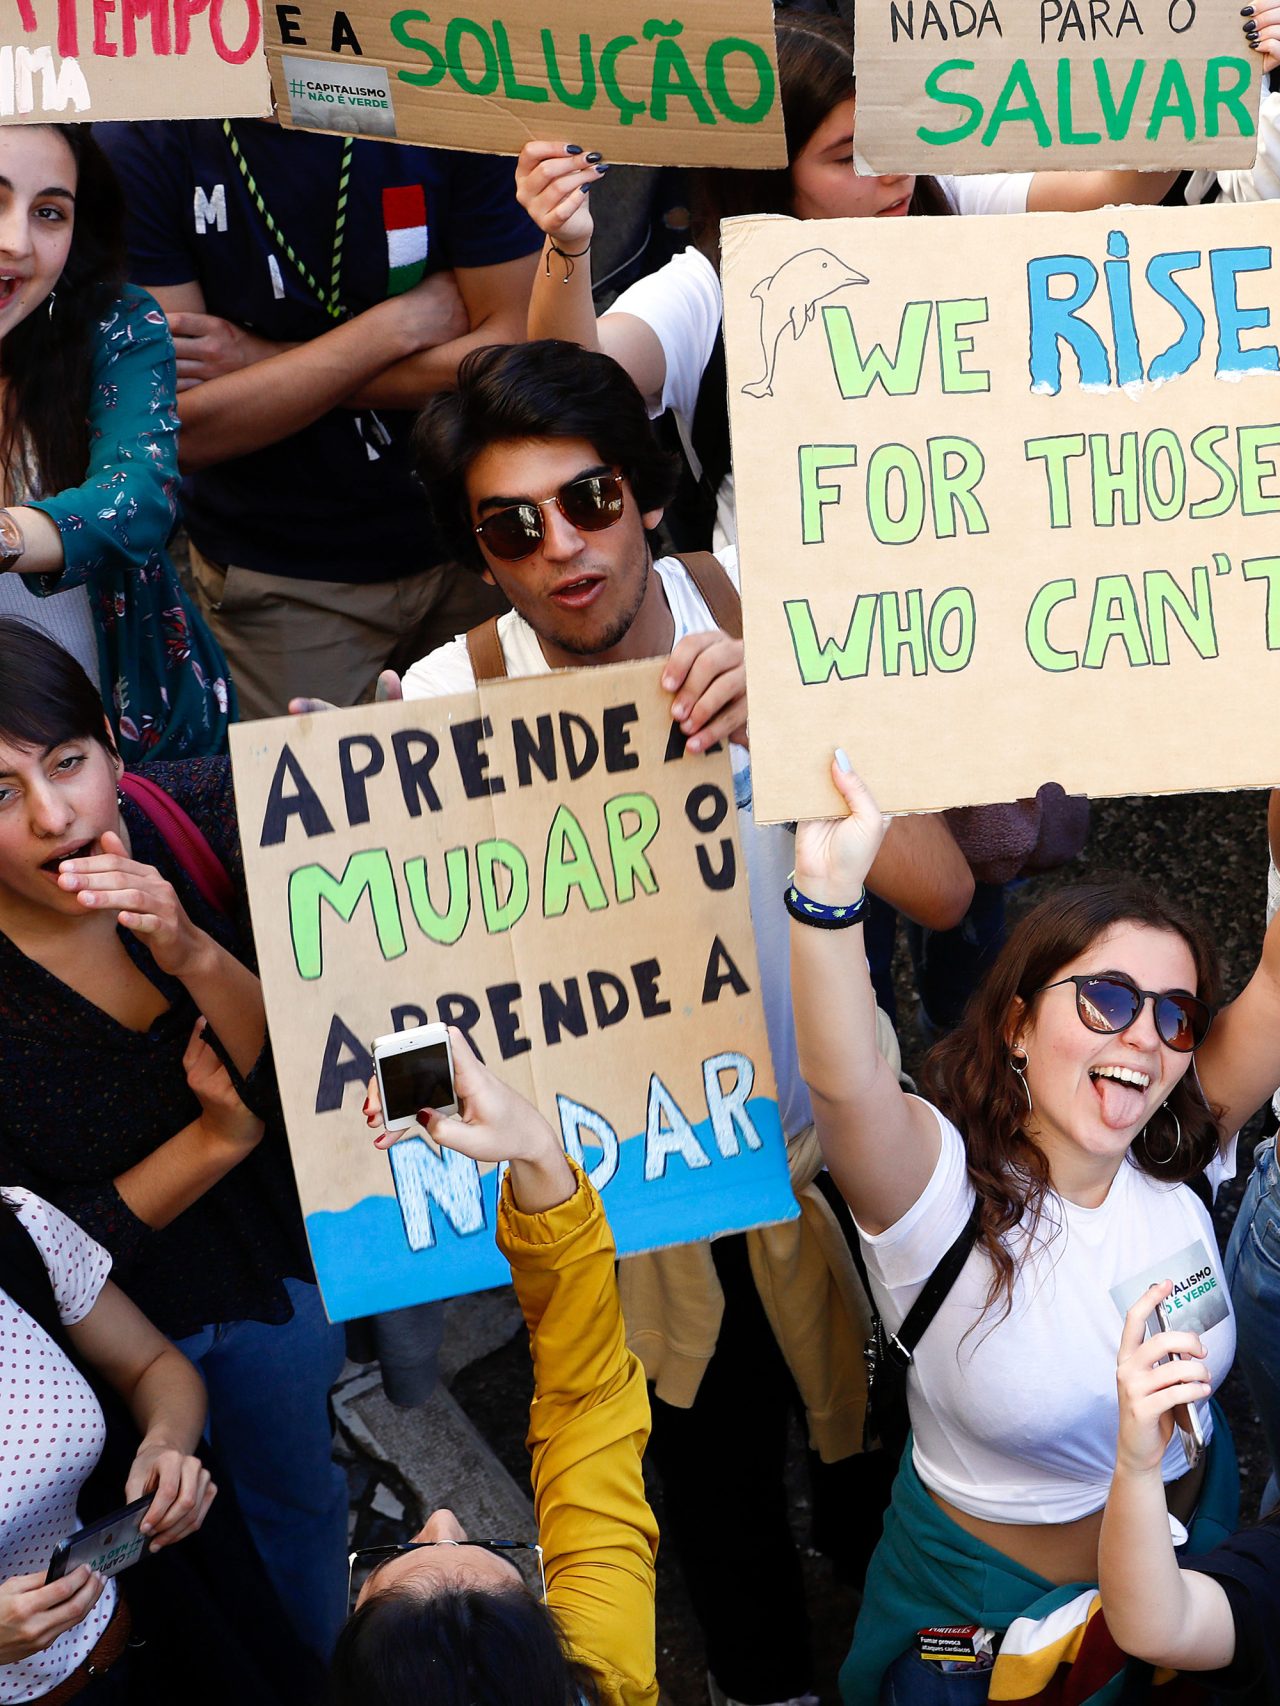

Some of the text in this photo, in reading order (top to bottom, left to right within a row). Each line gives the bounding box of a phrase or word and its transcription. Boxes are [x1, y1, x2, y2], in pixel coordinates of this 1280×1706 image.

[276, 4, 775, 126] E A SOLUÇÃO
[890, 0, 1197, 44] NADA PARA O
[308, 91, 335, 103] NÃO
[348, 96, 389, 109] VERDE
[916, 55, 1256, 149] SALVAR
[821, 297, 991, 400] WE
[798, 436, 989, 546] FOR
[783, 587, 977, 685] WHO
[259, 702, 640, 848] APRENDE
[288, 792, 661, 981] MUDAR
[701, 934, 751, 1004] A
[1183, 1277, 1218, 1303] VERDE
